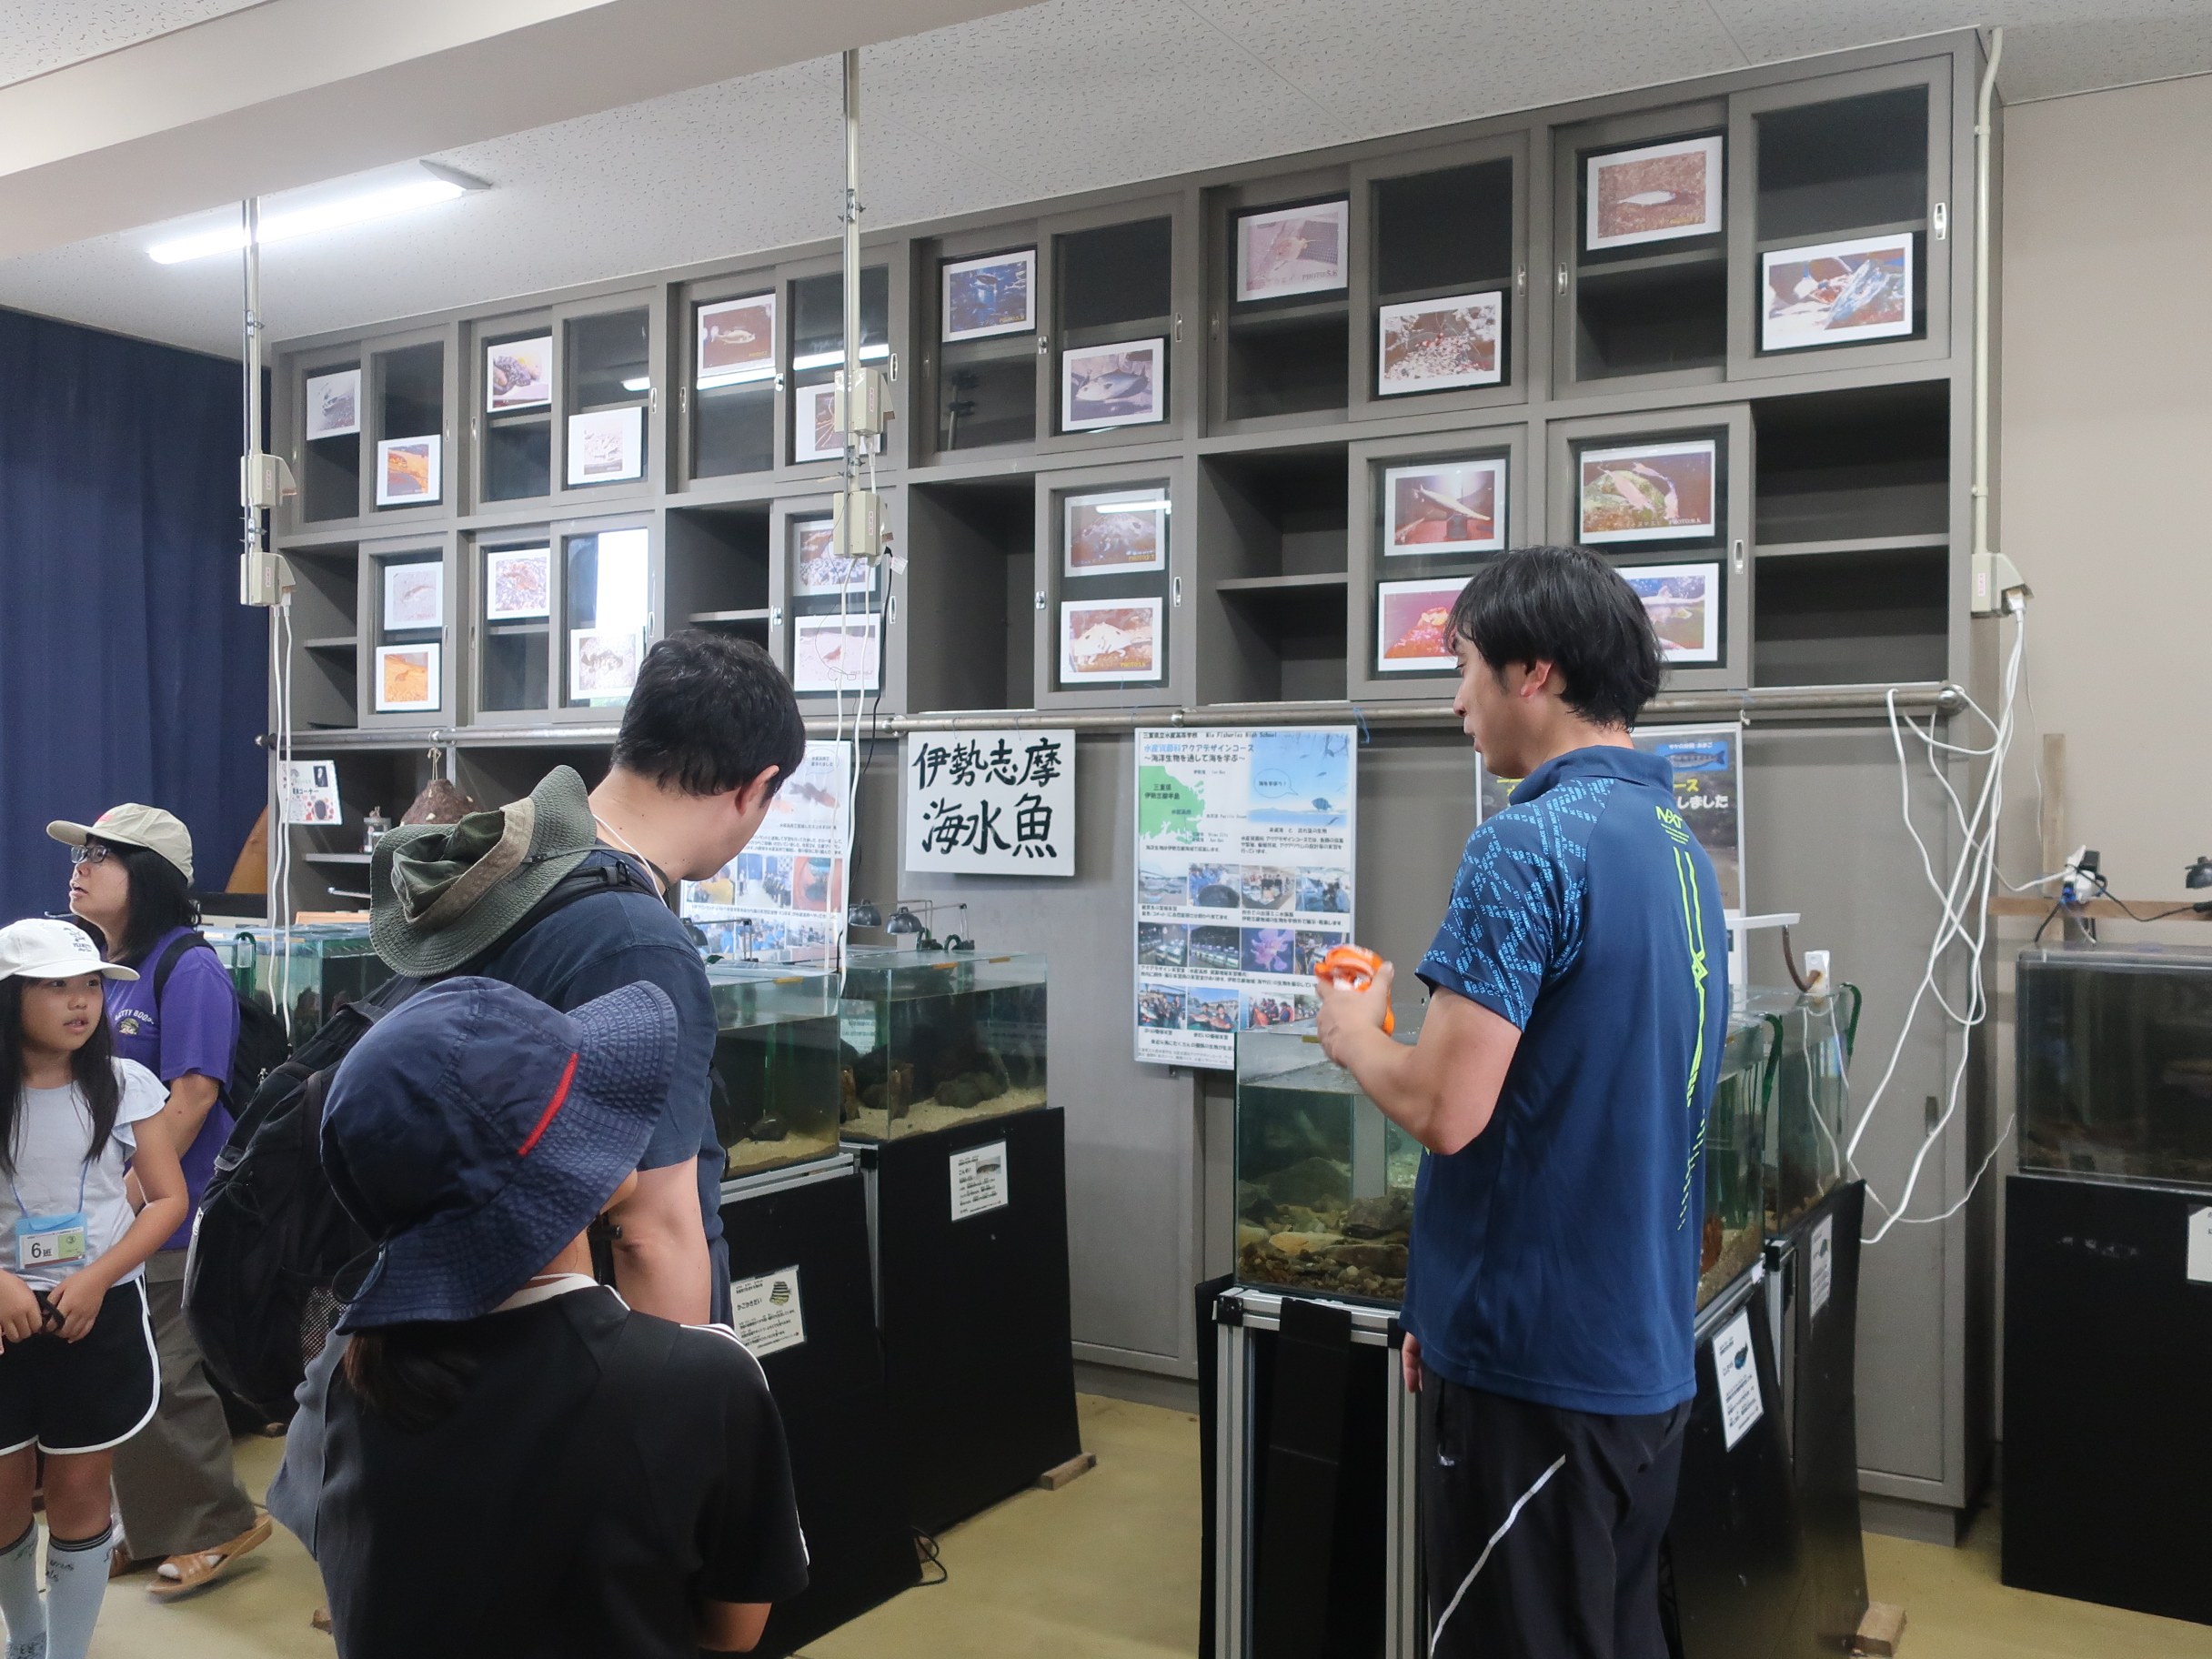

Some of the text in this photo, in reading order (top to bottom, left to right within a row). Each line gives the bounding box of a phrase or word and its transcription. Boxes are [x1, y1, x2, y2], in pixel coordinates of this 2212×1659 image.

[911, 737, 1061, 790] 伊勢志摩
[921, 792, 1058, 859] 海水魚
[1677, 795, 1729, 809] しました
